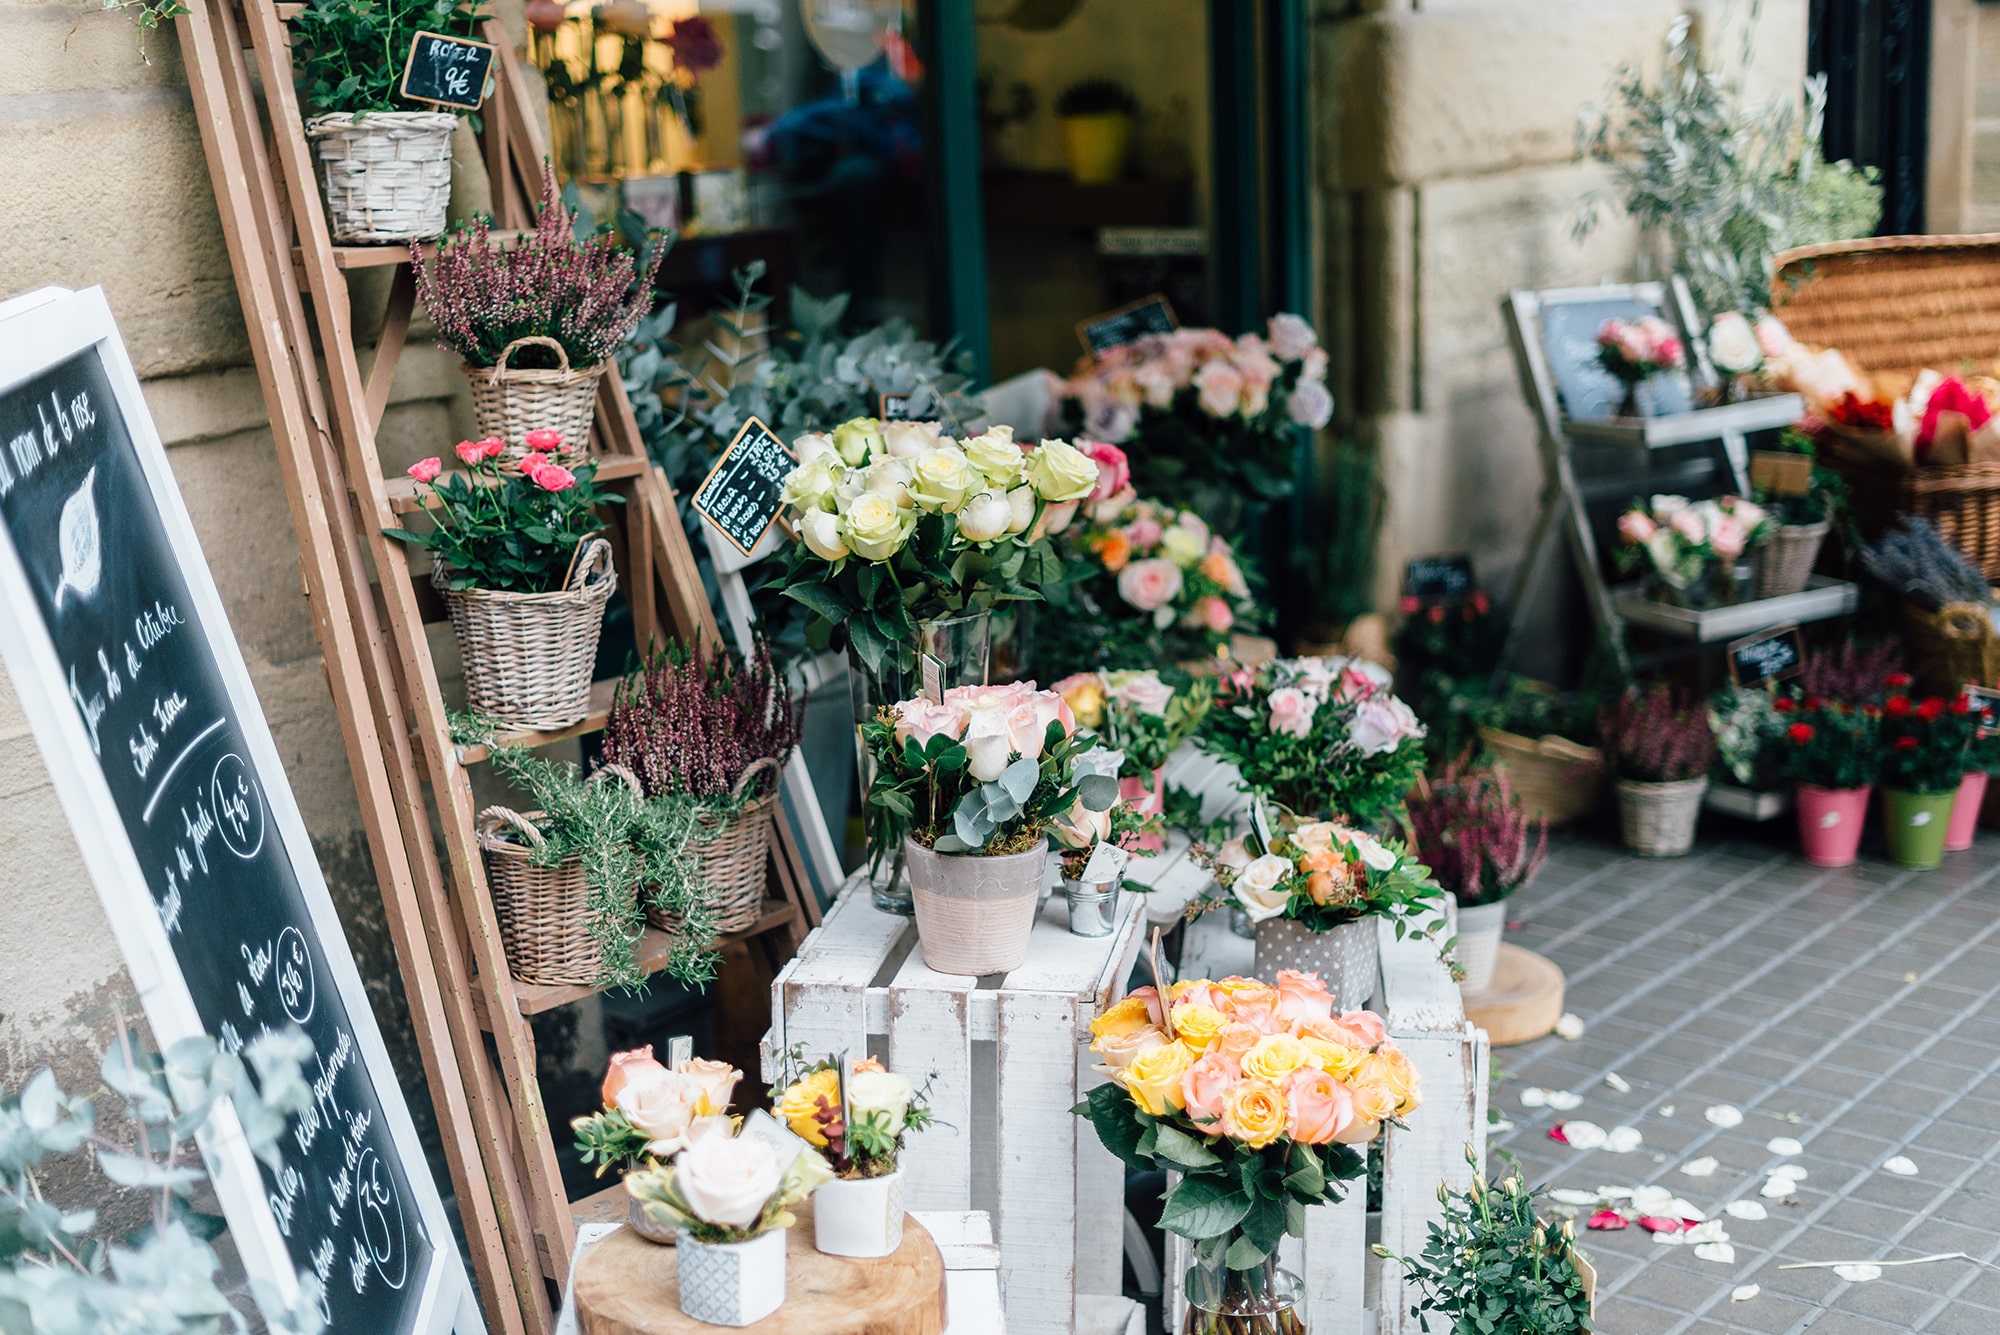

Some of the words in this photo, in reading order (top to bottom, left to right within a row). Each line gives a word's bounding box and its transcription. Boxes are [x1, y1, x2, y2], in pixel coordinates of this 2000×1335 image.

[445, 67, 471, 96] 9€
[10, 430, 42, 478] nom
[37, 403, 59, 457] de
[52, 391, 73, 446] la
[124, 641, 142, 680] de
